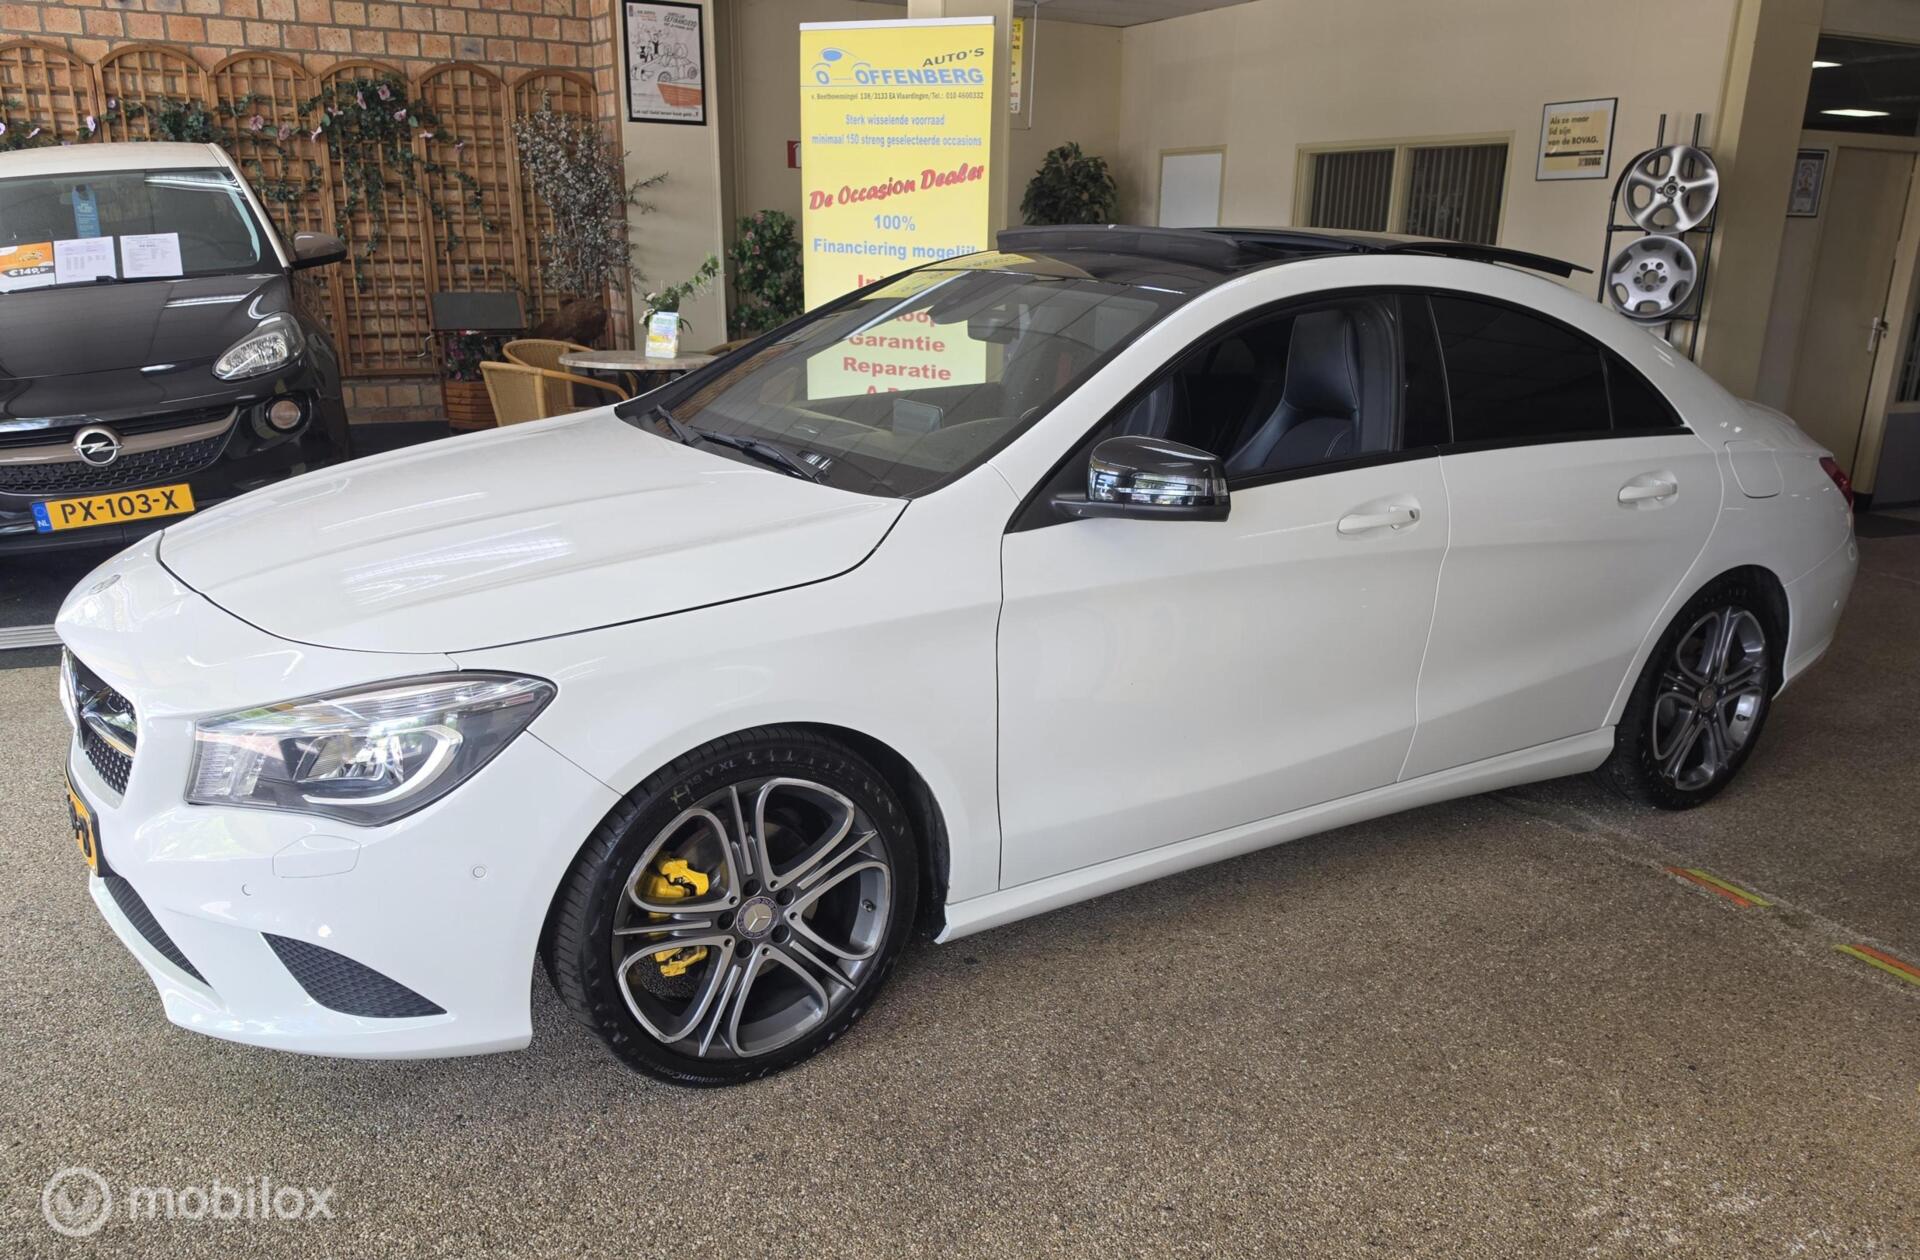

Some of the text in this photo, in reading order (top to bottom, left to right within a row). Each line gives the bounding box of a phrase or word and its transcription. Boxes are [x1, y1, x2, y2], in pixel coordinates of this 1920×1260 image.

[922, 48, 985, 67] AUTO'S
[855, 68, 984, 85] OFFENBERG
[845, 114, 945, 125] Sterk wisselende voorraad
[811, 133, 982, 148] minimaal 150 streng geselecteerde occasions
[1572, 136, 1599, 145] BOVAG.
[809, 163, 985, 210] De Occasion Dealer
[874, 214, 916, 231] 100%
[813, 238, 907, 260] Financiering
[849, 333, 945, 352] Garantie
[843, 357, 952, 381] Reparatie
[37, 489, 180, 528] NL PX-103-X
